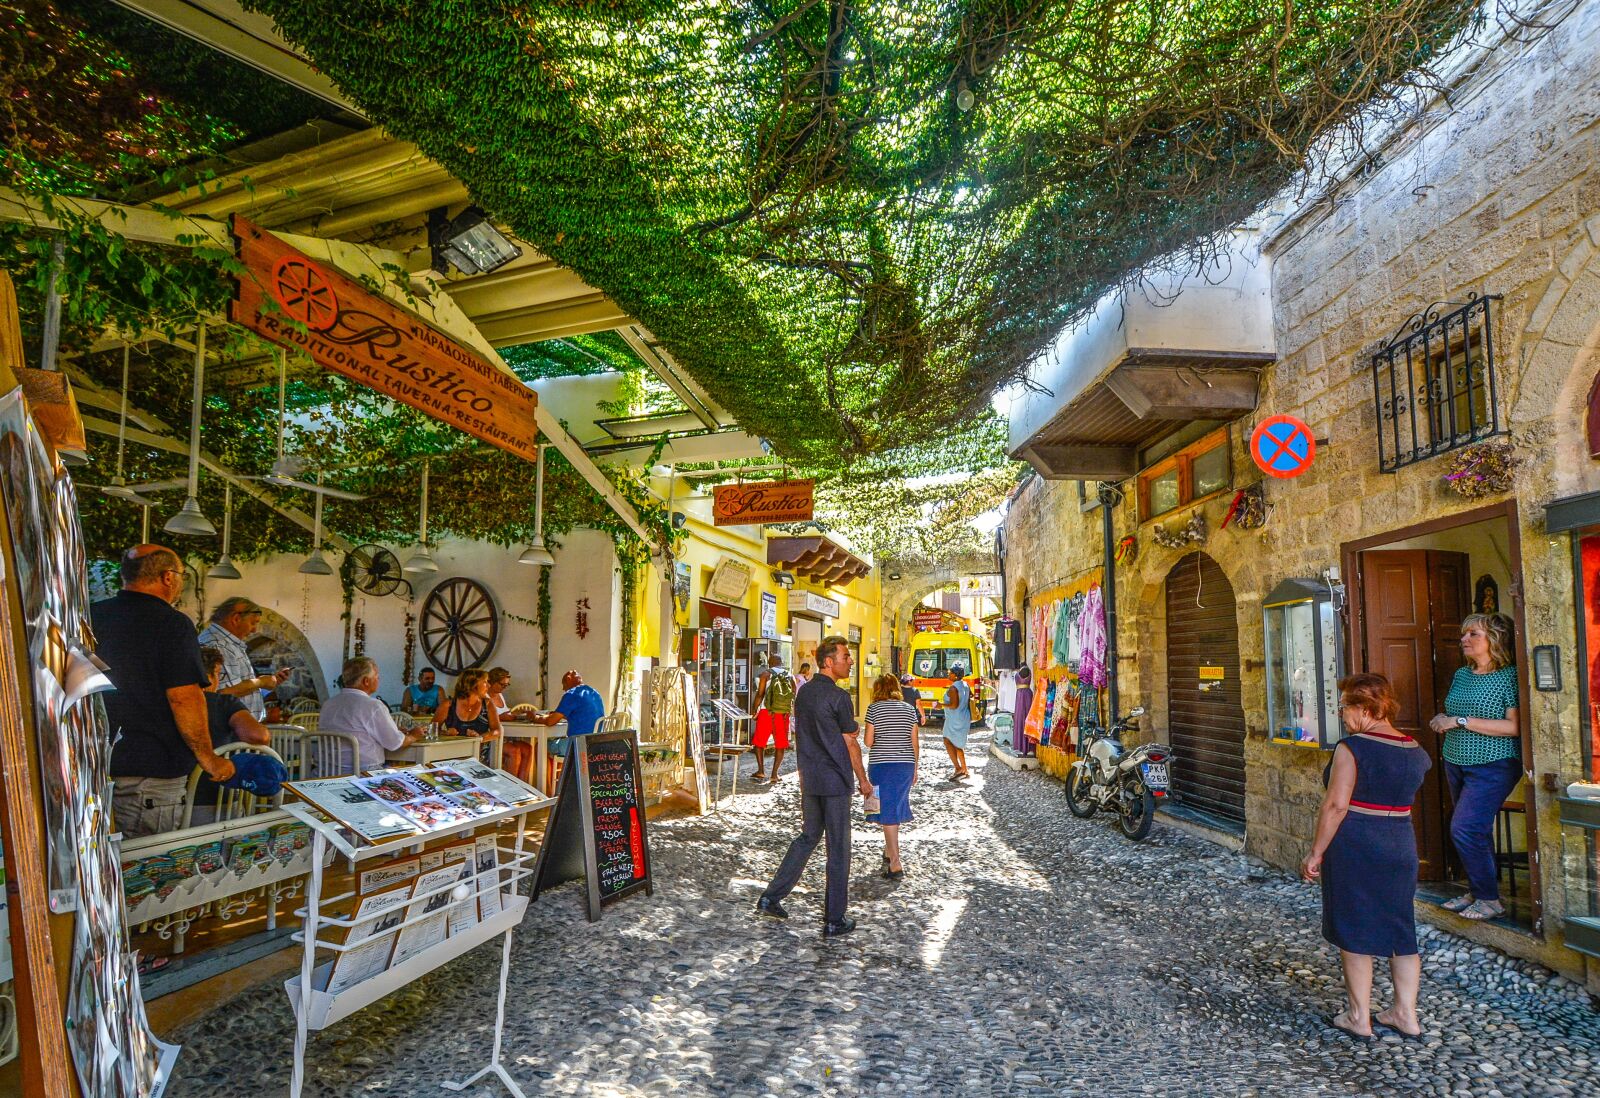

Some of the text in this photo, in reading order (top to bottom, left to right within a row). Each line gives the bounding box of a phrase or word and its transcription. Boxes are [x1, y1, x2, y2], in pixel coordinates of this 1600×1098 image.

[320, 309, 493, 412] Rustico
[733, 489, 809, 515] Rustico
[591, 772, 624, 782] MUSIC
